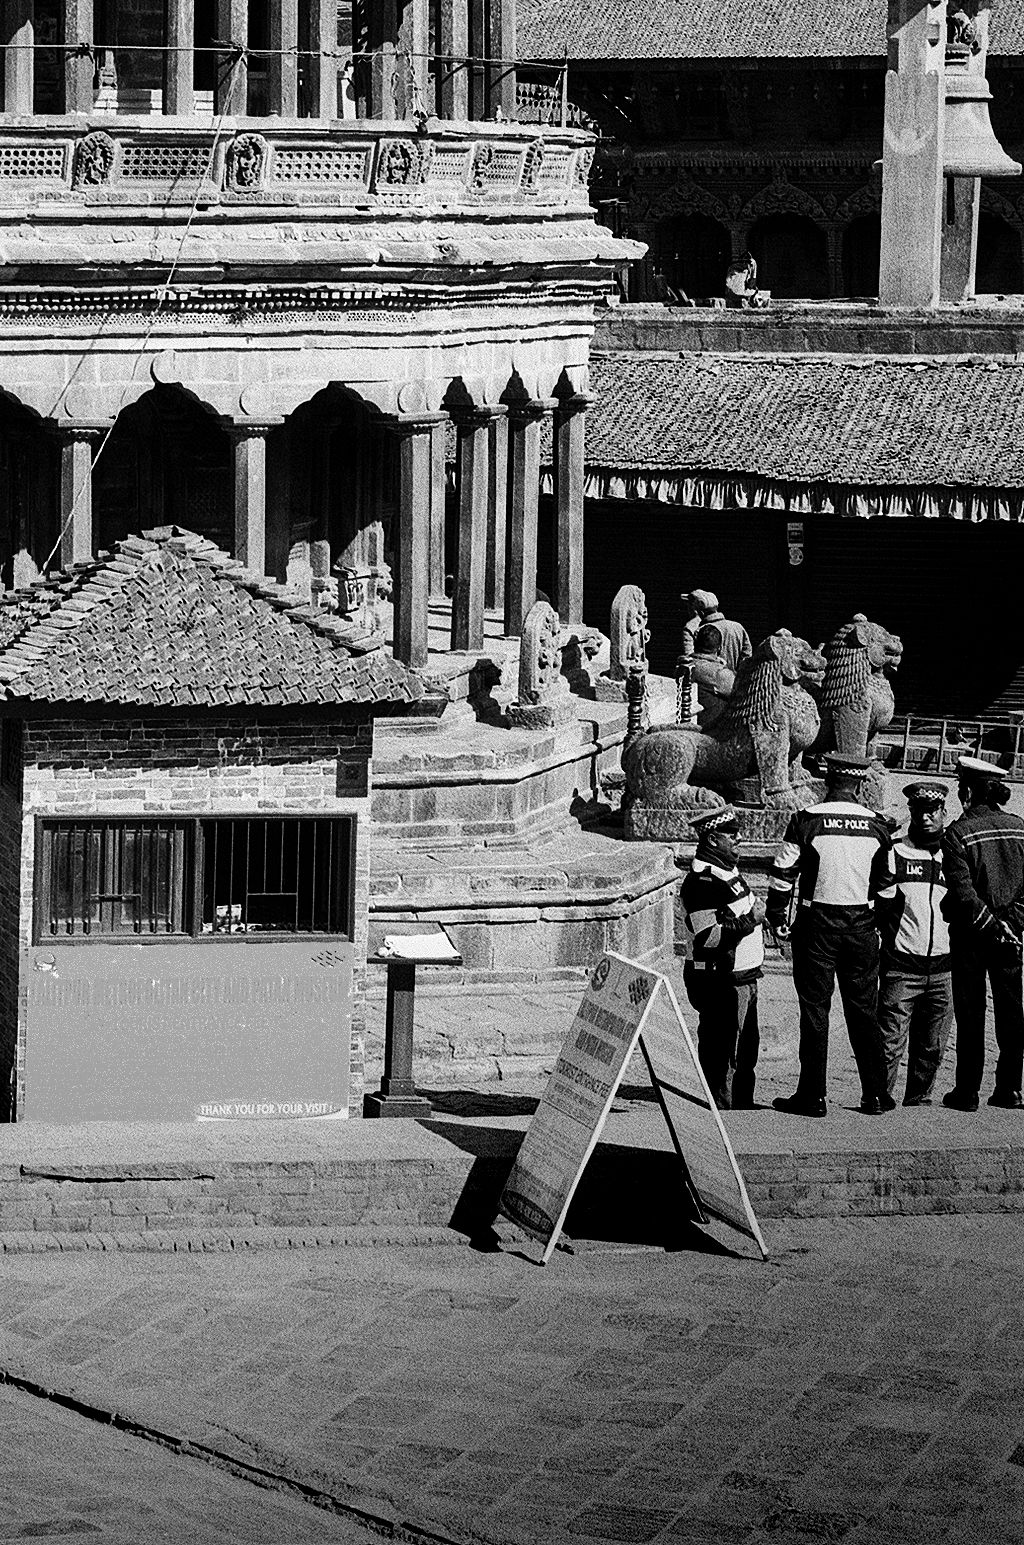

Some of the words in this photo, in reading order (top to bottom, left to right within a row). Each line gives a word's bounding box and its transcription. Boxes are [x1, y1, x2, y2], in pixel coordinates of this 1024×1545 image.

[823, 818, 843, 829] LMC
[844, 819, 870, 830] POLICE
[906, 861, 923, 876] LMC
[200, 1104, 232, 1115] THANK
[234, 1104, 255, 1114] YOU
[256, 1104, 274, 1114] FOR
[276, 1104, 303, 1114] YOUR
[304, 1103, 328, 1114] VISIT
